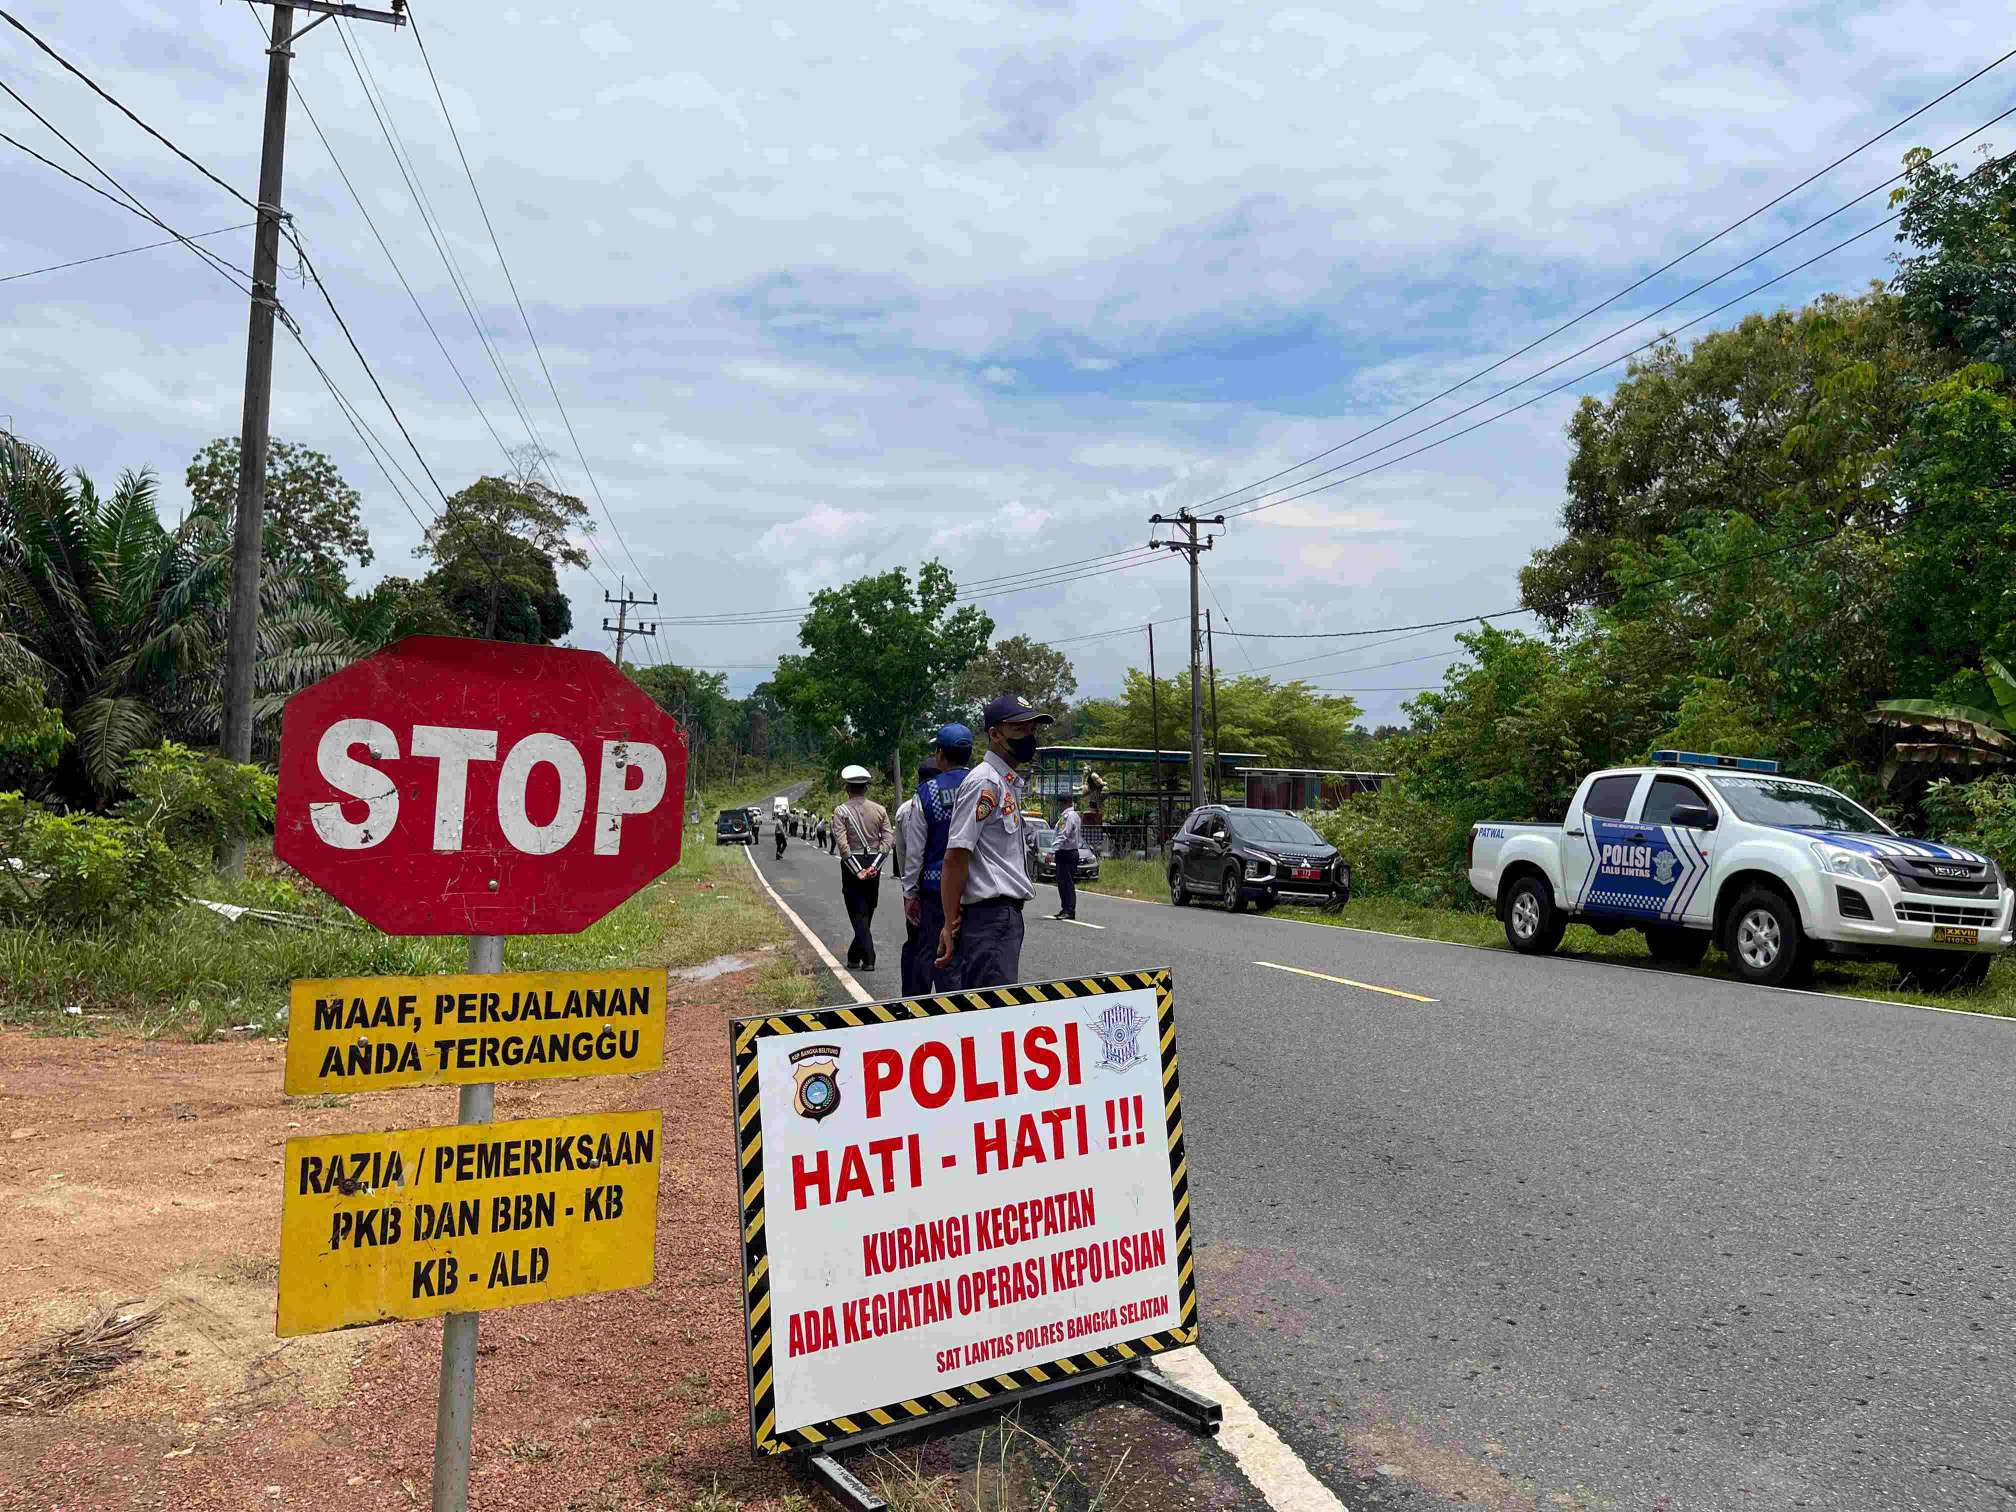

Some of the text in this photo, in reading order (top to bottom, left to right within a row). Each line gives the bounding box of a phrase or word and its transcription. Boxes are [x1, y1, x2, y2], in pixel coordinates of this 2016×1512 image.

[309, 718, 667, 856] STOP
[1478, 827, 1504, 838] PATWAL
[1602, 844, 1651, 868] POLISI
[1601, 866, 1650, 877] LALU LINTAS
[1934, 866, 1970, 878] ISUZU
[1946, 928, 1977, 937] XXVIII
[314, 987, 650, 1033] MAAF, PERJALANAN
[319, 1030, 639, 1078] ANDA TERGANGGU
[863, 1022, 1081, 1118] POLISI
[299, 1129, 654, 1196] RAZIA / PEMERIKSAAN
[792, 1094, 1146, 1211] HATI - HATI !!!
[330, 1203, 401, 1250] PKB
[413, 1199, 480, 1242] DAN
[491, 1191, 555, 1233] BBN
[583, 1185, 624, 1222] KB
[862, 1188, 1096, 1276] KURANGI KECEPATAN
[412, 1256, 459, 1299] KB
[488, 1247, 549, 1289] ALD
[788, 1228, 1166, 1358] ADA KEGIATAN OPERASI KEPOLISIAN
[936, 1295, 1169, 1373] SAT LANTAS POLRES BANGKA SELATAN
